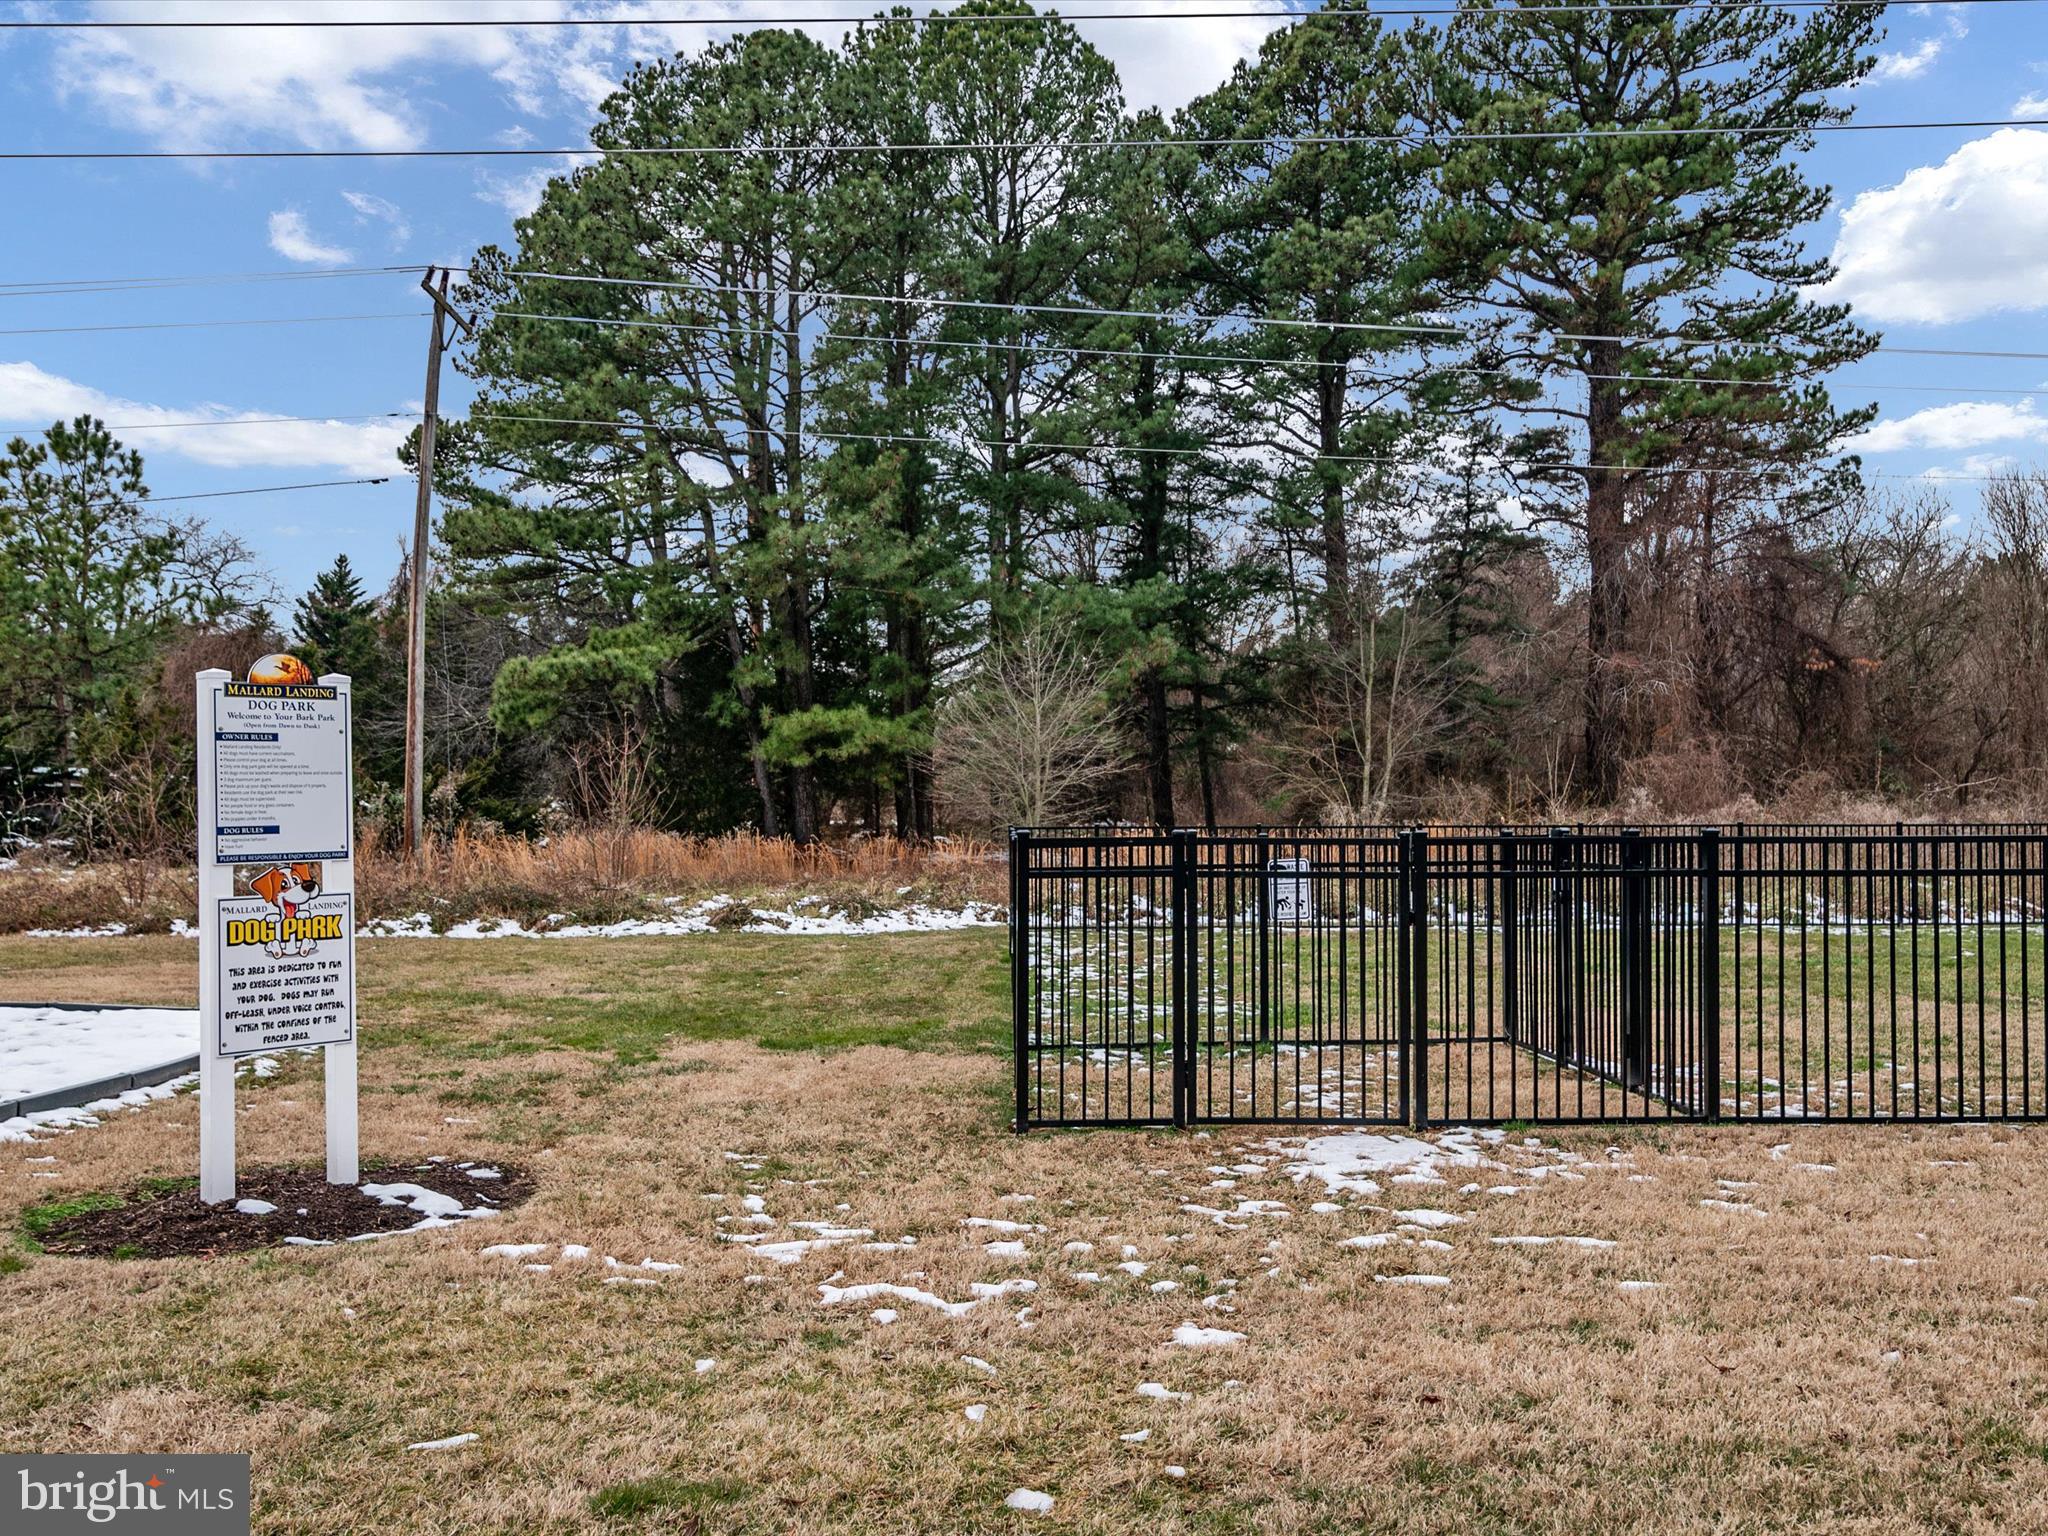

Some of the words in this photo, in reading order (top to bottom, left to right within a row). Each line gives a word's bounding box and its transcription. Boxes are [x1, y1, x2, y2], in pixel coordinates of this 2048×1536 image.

[228, 684, 281, 697] MALLARD
[286, 686, 334, 698] LANDING
[248, 700, 277, 711] DOG
[282, 701, 316, 712] PARK
[227, 712, 261, 720] Welcome
[226, 906, 267, 915] MALLARD
[308, 902, 343, 910] LANDING
[227, 920, 276, 946] DOG
[280, 914, 342, 942] PARK
[229, 968, 245, 977] THIS
[248, 966, 265, 975] AREA
[268, 966, 275, 974] IS
[278, 962, 314, 973] DEDICATED
[317, 962, 326, 970] TO
[329, 960, 342, 969] FUN
[232, 982, 246, 990] AND
[250, 978, 281, 989] EXERCISE
[284, 976, 320, 986] ACTIVITIES
[323, 974, 339, 982] WITH
[237, 995, 255, 1004] YOUR
[258, 994, 275, 1002] DOG.
[281, 991, 300, 1000] DOGS
[303, 990, 318, 998] MAY
[321, 988, 334, 996] RUN
[268, 1006, 290, 1016] UNDER
[293, 1004, 312, 1013] VOICE
[235, 1024, 259, 1033] WITHIN
[262, 1022, 274, 1030] THE
[277, 1018, 310, 1028] CONFINES
[313, 1016, 321, 1024] OF
[324, 1015, 336, 1024] THE
[263, 1033, 288, 1044] FENCED
[291, 1032, 310, 1040] AREA.
